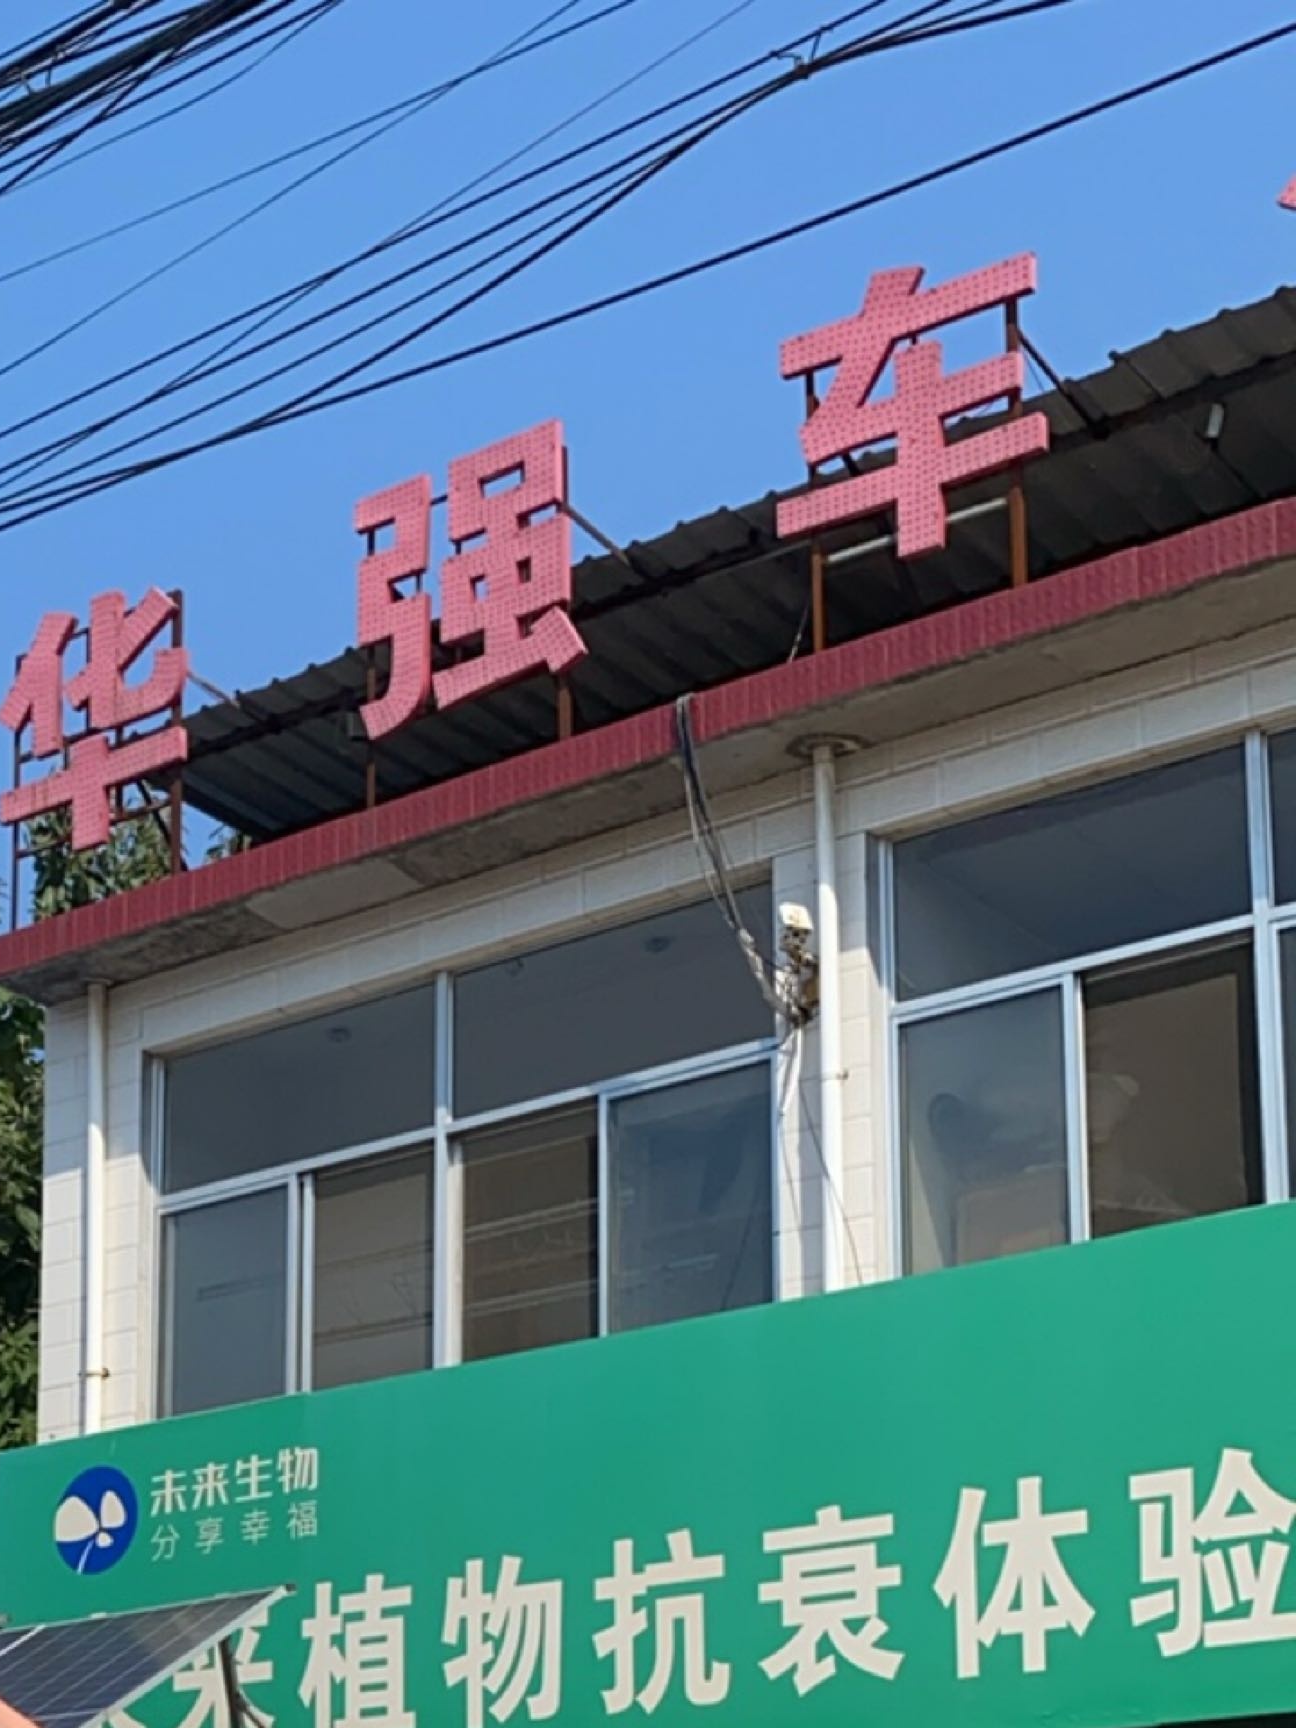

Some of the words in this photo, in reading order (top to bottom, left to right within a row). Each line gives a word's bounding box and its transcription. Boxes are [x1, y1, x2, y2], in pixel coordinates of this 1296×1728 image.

[150, 1446, 319, 1518] 未来生物
[150, 1500, 318, 1562] 分享幸福
